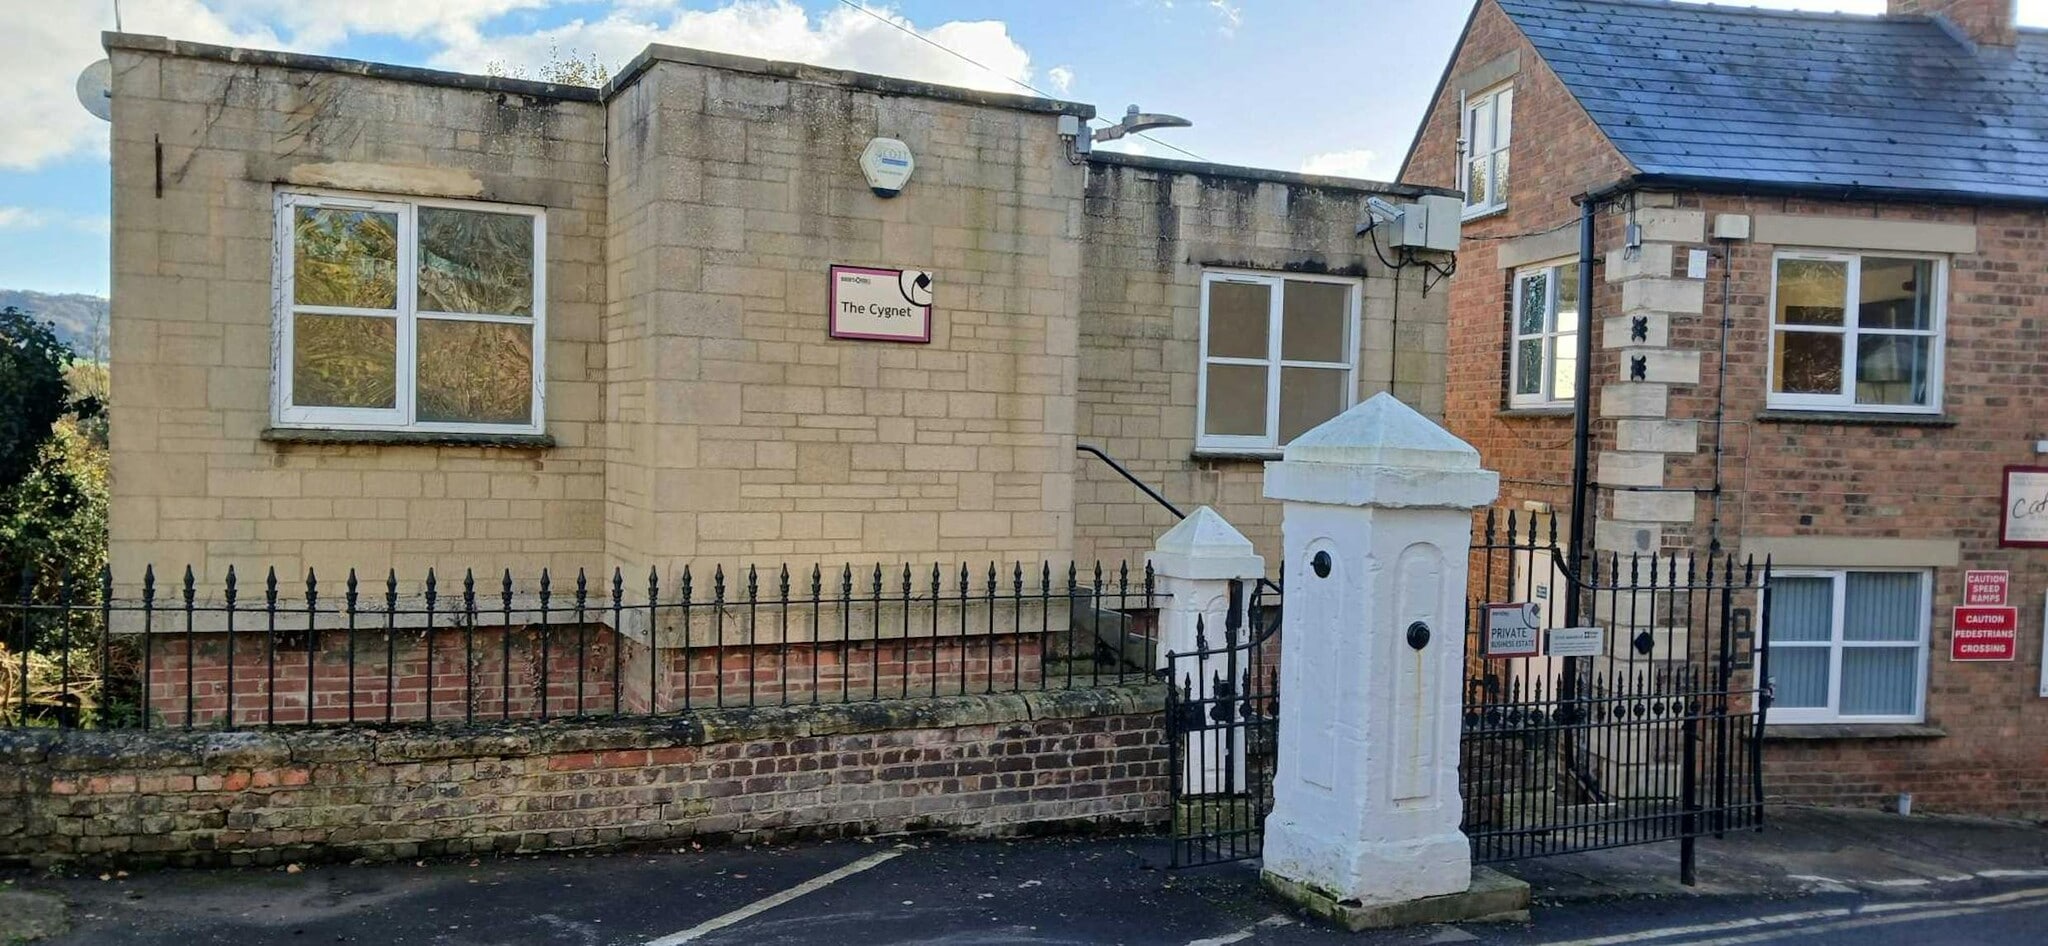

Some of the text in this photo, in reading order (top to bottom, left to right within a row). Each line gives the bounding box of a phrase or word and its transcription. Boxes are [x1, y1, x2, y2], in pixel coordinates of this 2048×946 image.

[841, 301, 912, 319] The Cygnet
[1968, 575, 2006, 583] CAUTION
[1972, 584, 2000, 593] SPEED
[1971, 594, 2001, 602] RAMPS
[1965, 615, 2005, 623] CAUTION
[1491, 627, 1527, 639] PRIVATE
[1955, 629, 2014, 638] PEDESTRIANS
[1515, 640, 1534, 648] ESTATE
[1960, 644, 2006, 653] CROSSING
